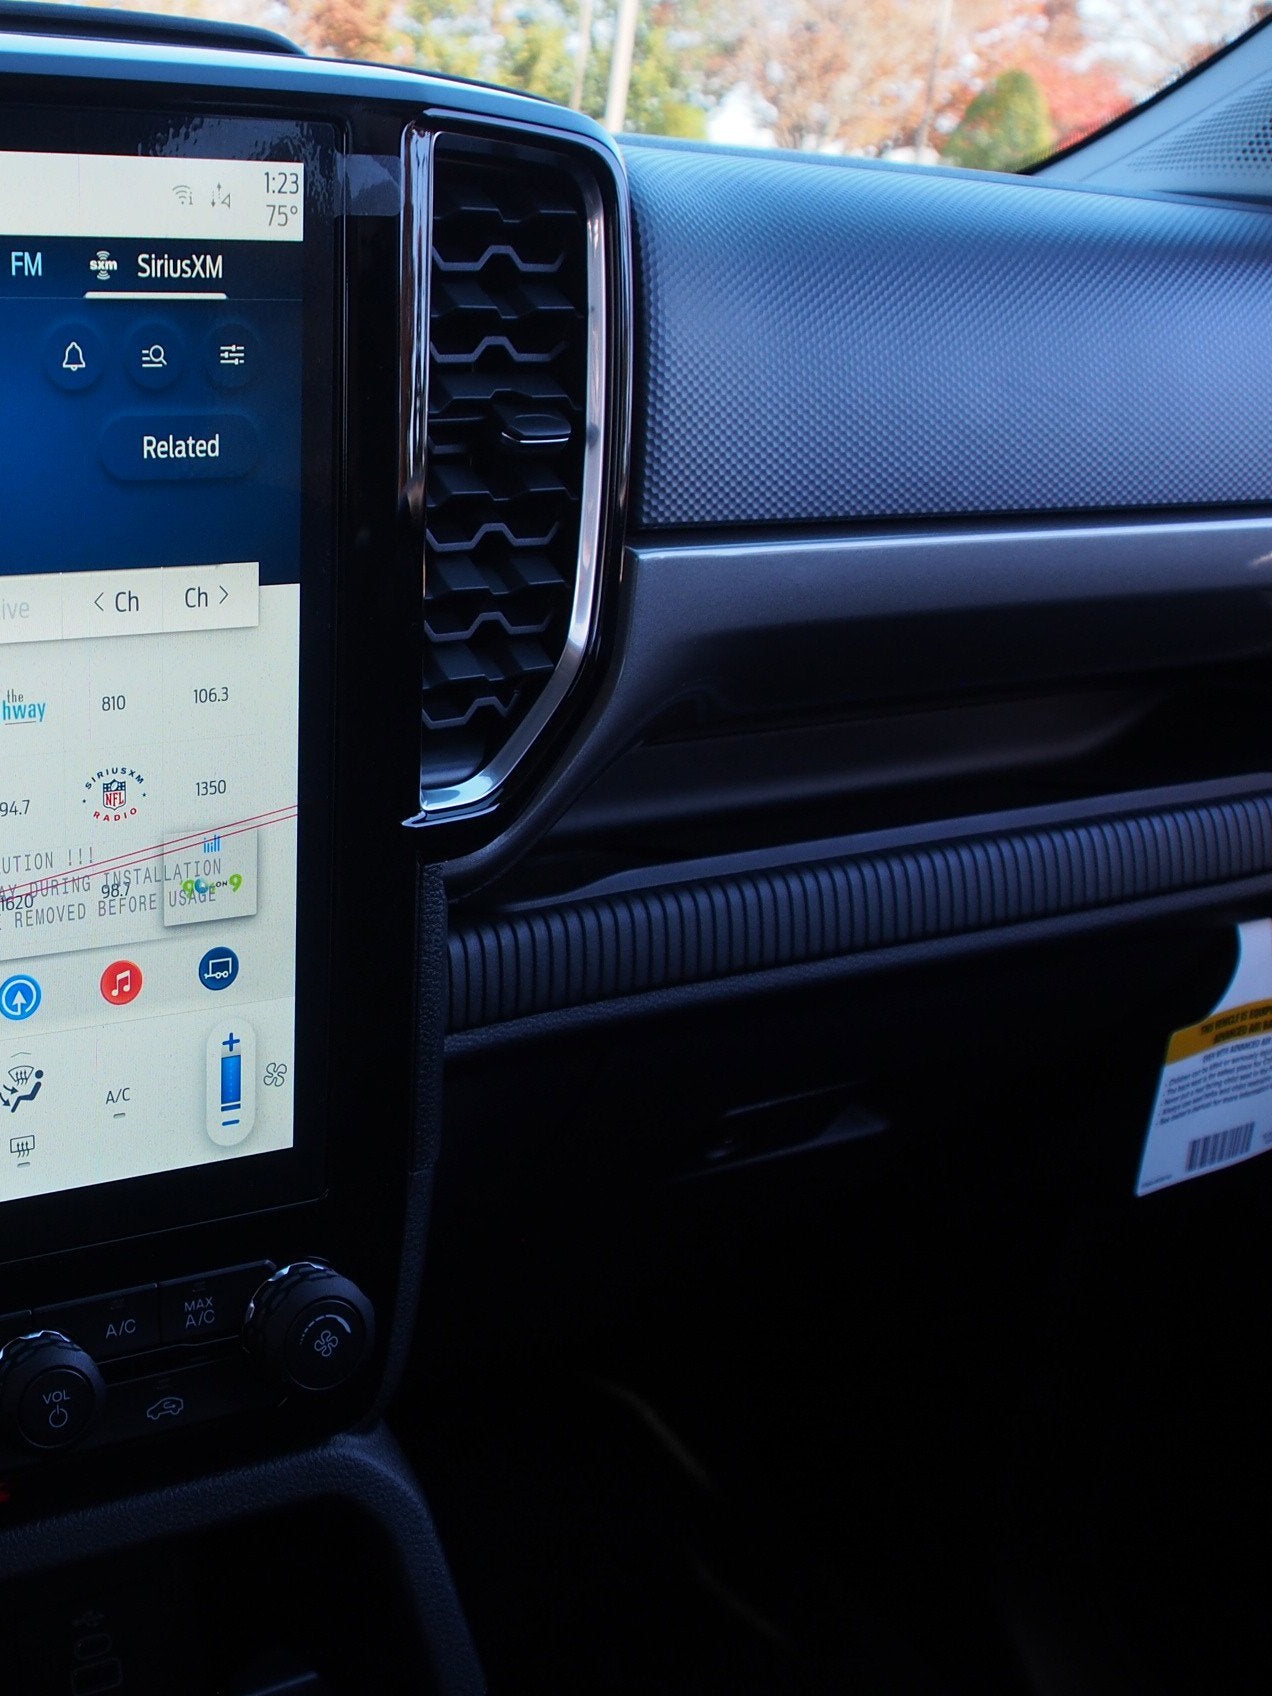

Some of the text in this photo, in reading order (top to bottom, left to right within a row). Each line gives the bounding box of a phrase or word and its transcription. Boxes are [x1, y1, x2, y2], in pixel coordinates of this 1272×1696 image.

[265, 172, 299, 194] 1:23
[266, 205, 298, 226] 75°
[11, 252, 42, 276] FM
[89, 259, 118, 271] sxm
[137, 254, 223, 279] SiriusXM
[143, 434, 219, 459] Related
[115, 590, 139, 612] Ch
[184, 587, 208, 608] Ch
[6, 689, 24, 703] the
[101, 695, 126, 711] 810
[193, 687, 229, 703] 106.3
[84, 767, 145, 790] SIRIUSXM
[196, 780, 227, 796] 1350
[0, 800, 30, 817] 94.7
[105, 792, 124, 807] NFL
[93, 807, 137, 822] RADIO
[29, 875, 91, 899] DURING
[104, 858, 222, 887] INSTALLATION
[101, 881, 131, 899] 98.7
[1, 894, 34, 911] 1620
[14, 903, 86, 928] REMOVED
[98, 893, 157, 917] BEFORE
[168, 885, 217, 908] USAGE
[106, 1087, 131, 1105] A/C
[184, 1297, 213, 1312] MAX
[185, 1310, 215, 1329] A/C
[106, 1319, 136, 1339] A/C
[42, 1390, 70, 1405] VOL
